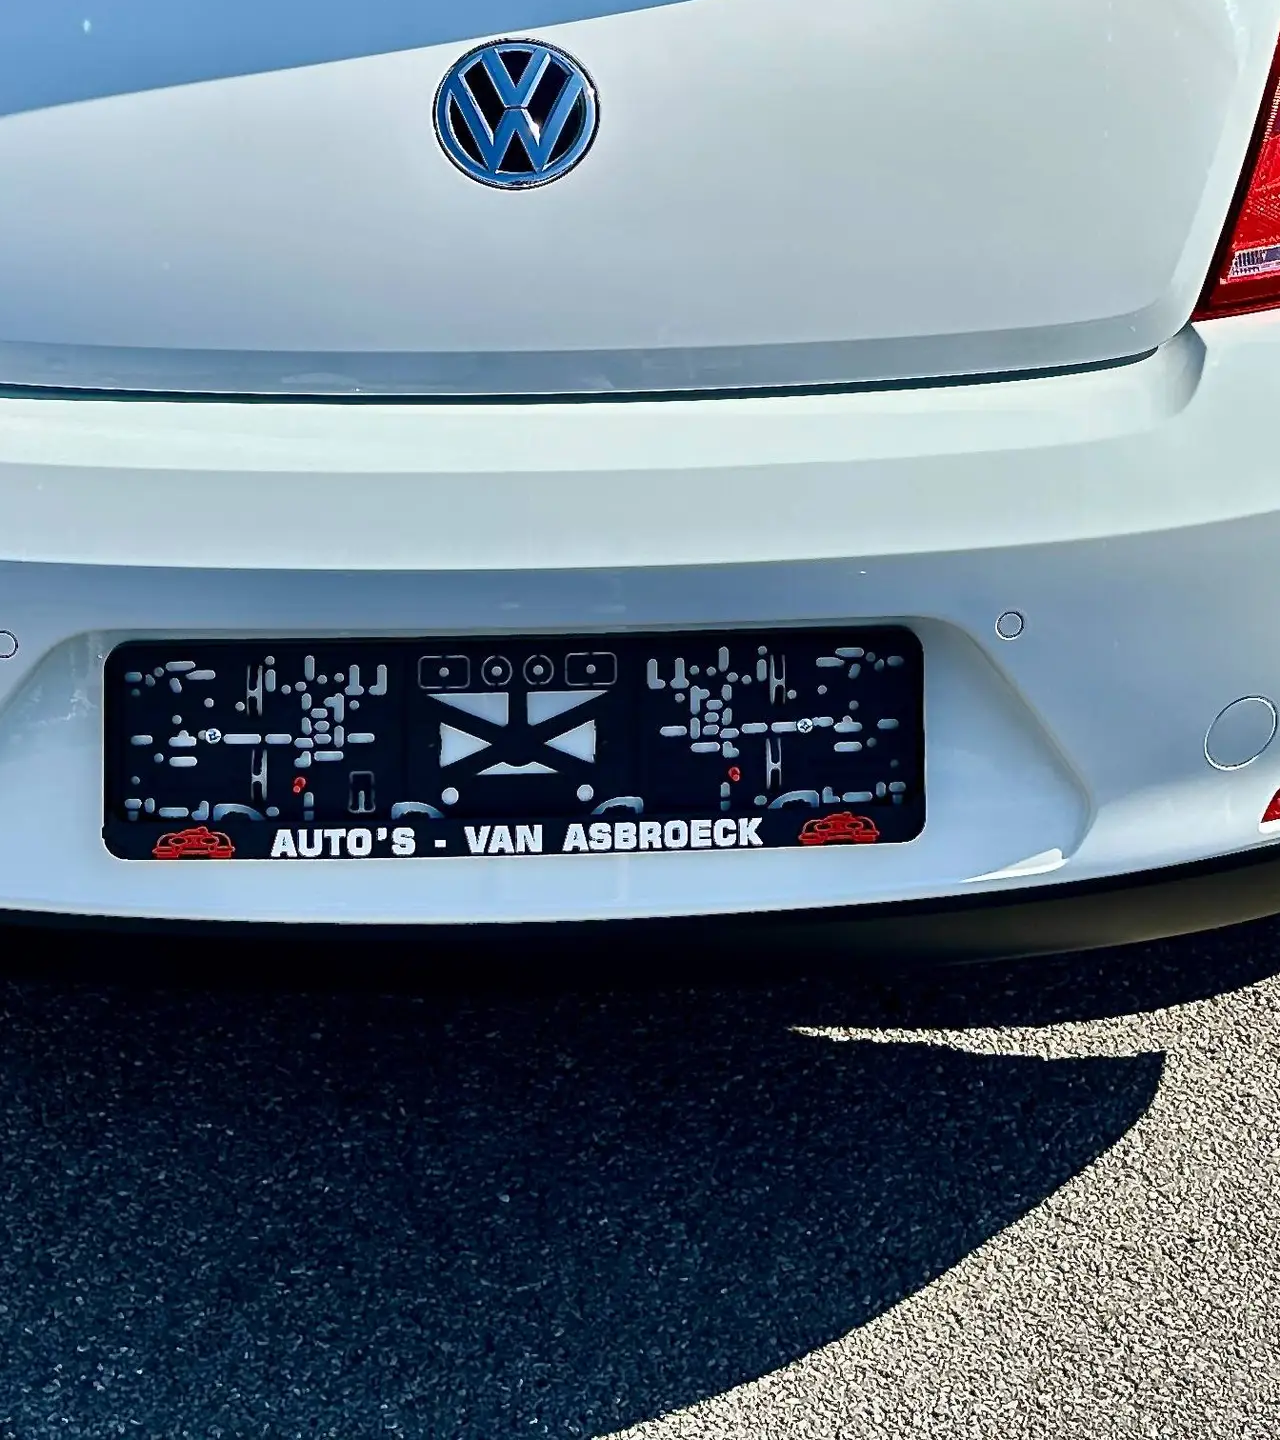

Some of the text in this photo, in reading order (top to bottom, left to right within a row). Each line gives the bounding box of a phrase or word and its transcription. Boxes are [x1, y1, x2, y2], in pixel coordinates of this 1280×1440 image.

[441, 42, 593, 179] VW
[270, 827, 416, 858] AUTO'S
[464, 824, 543, 854] VAN
[562, 817, 764, 852] ASBROECK
